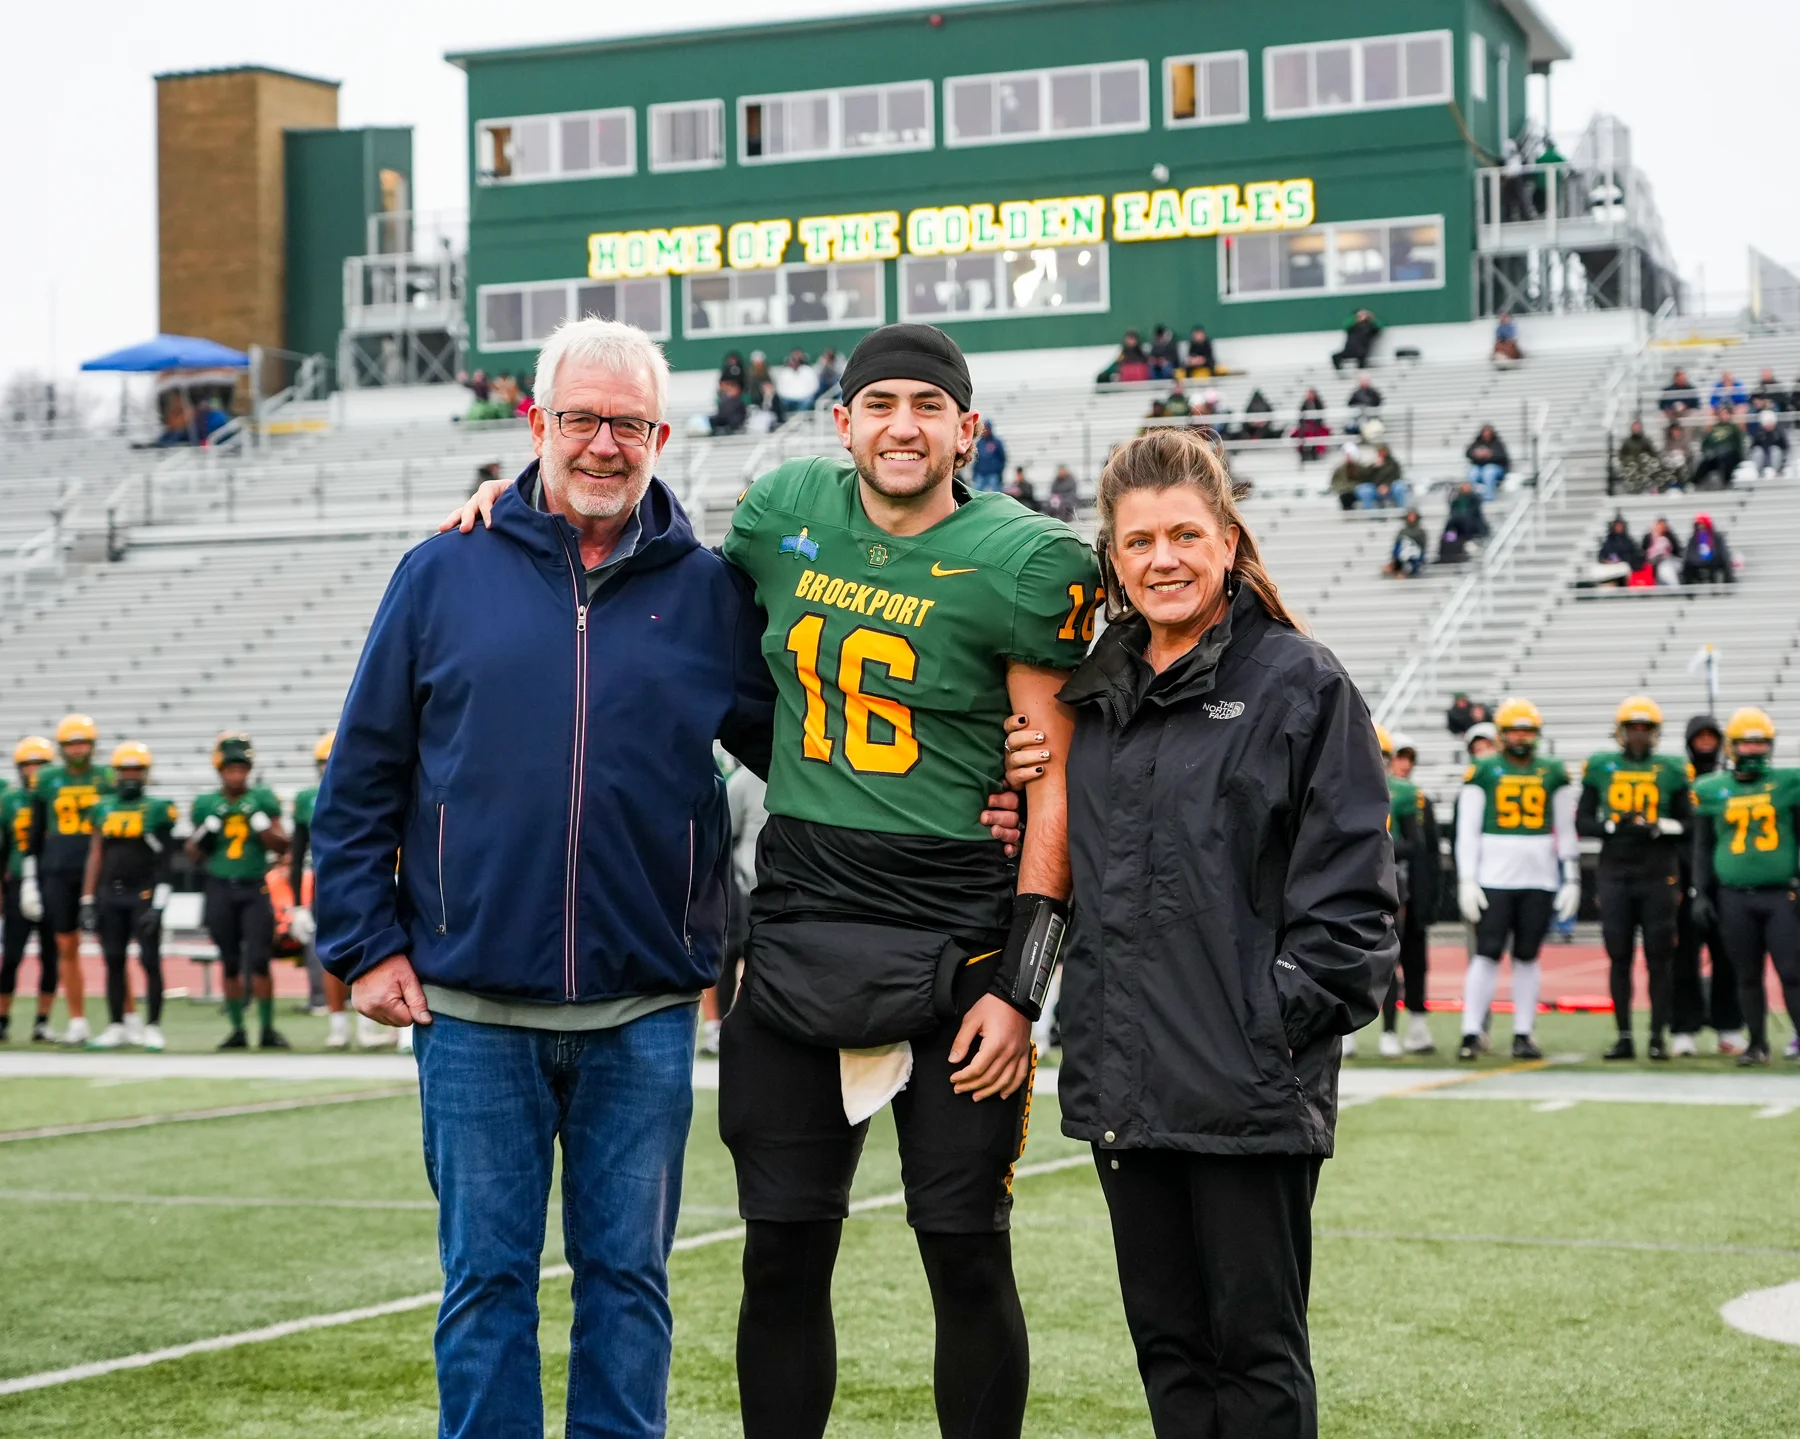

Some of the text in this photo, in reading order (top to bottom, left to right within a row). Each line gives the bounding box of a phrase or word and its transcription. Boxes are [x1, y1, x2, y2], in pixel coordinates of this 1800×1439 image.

[589, 178, 1314, 279] HOME OF THE GOLDEN EAGLES
[795, 569, 935, 627] BROCKPORT
[786, 612, 920, 776] 16
[1202, 703, 1232, 714] NORTH
[1208, 712, 1230, 720] FACE
[1219, 700, 1234, 708] THE
[1495, 784, 1546, 829] 59
[1725, 803, 1779, 854] 73
[224, 822, 249, 859] 7
